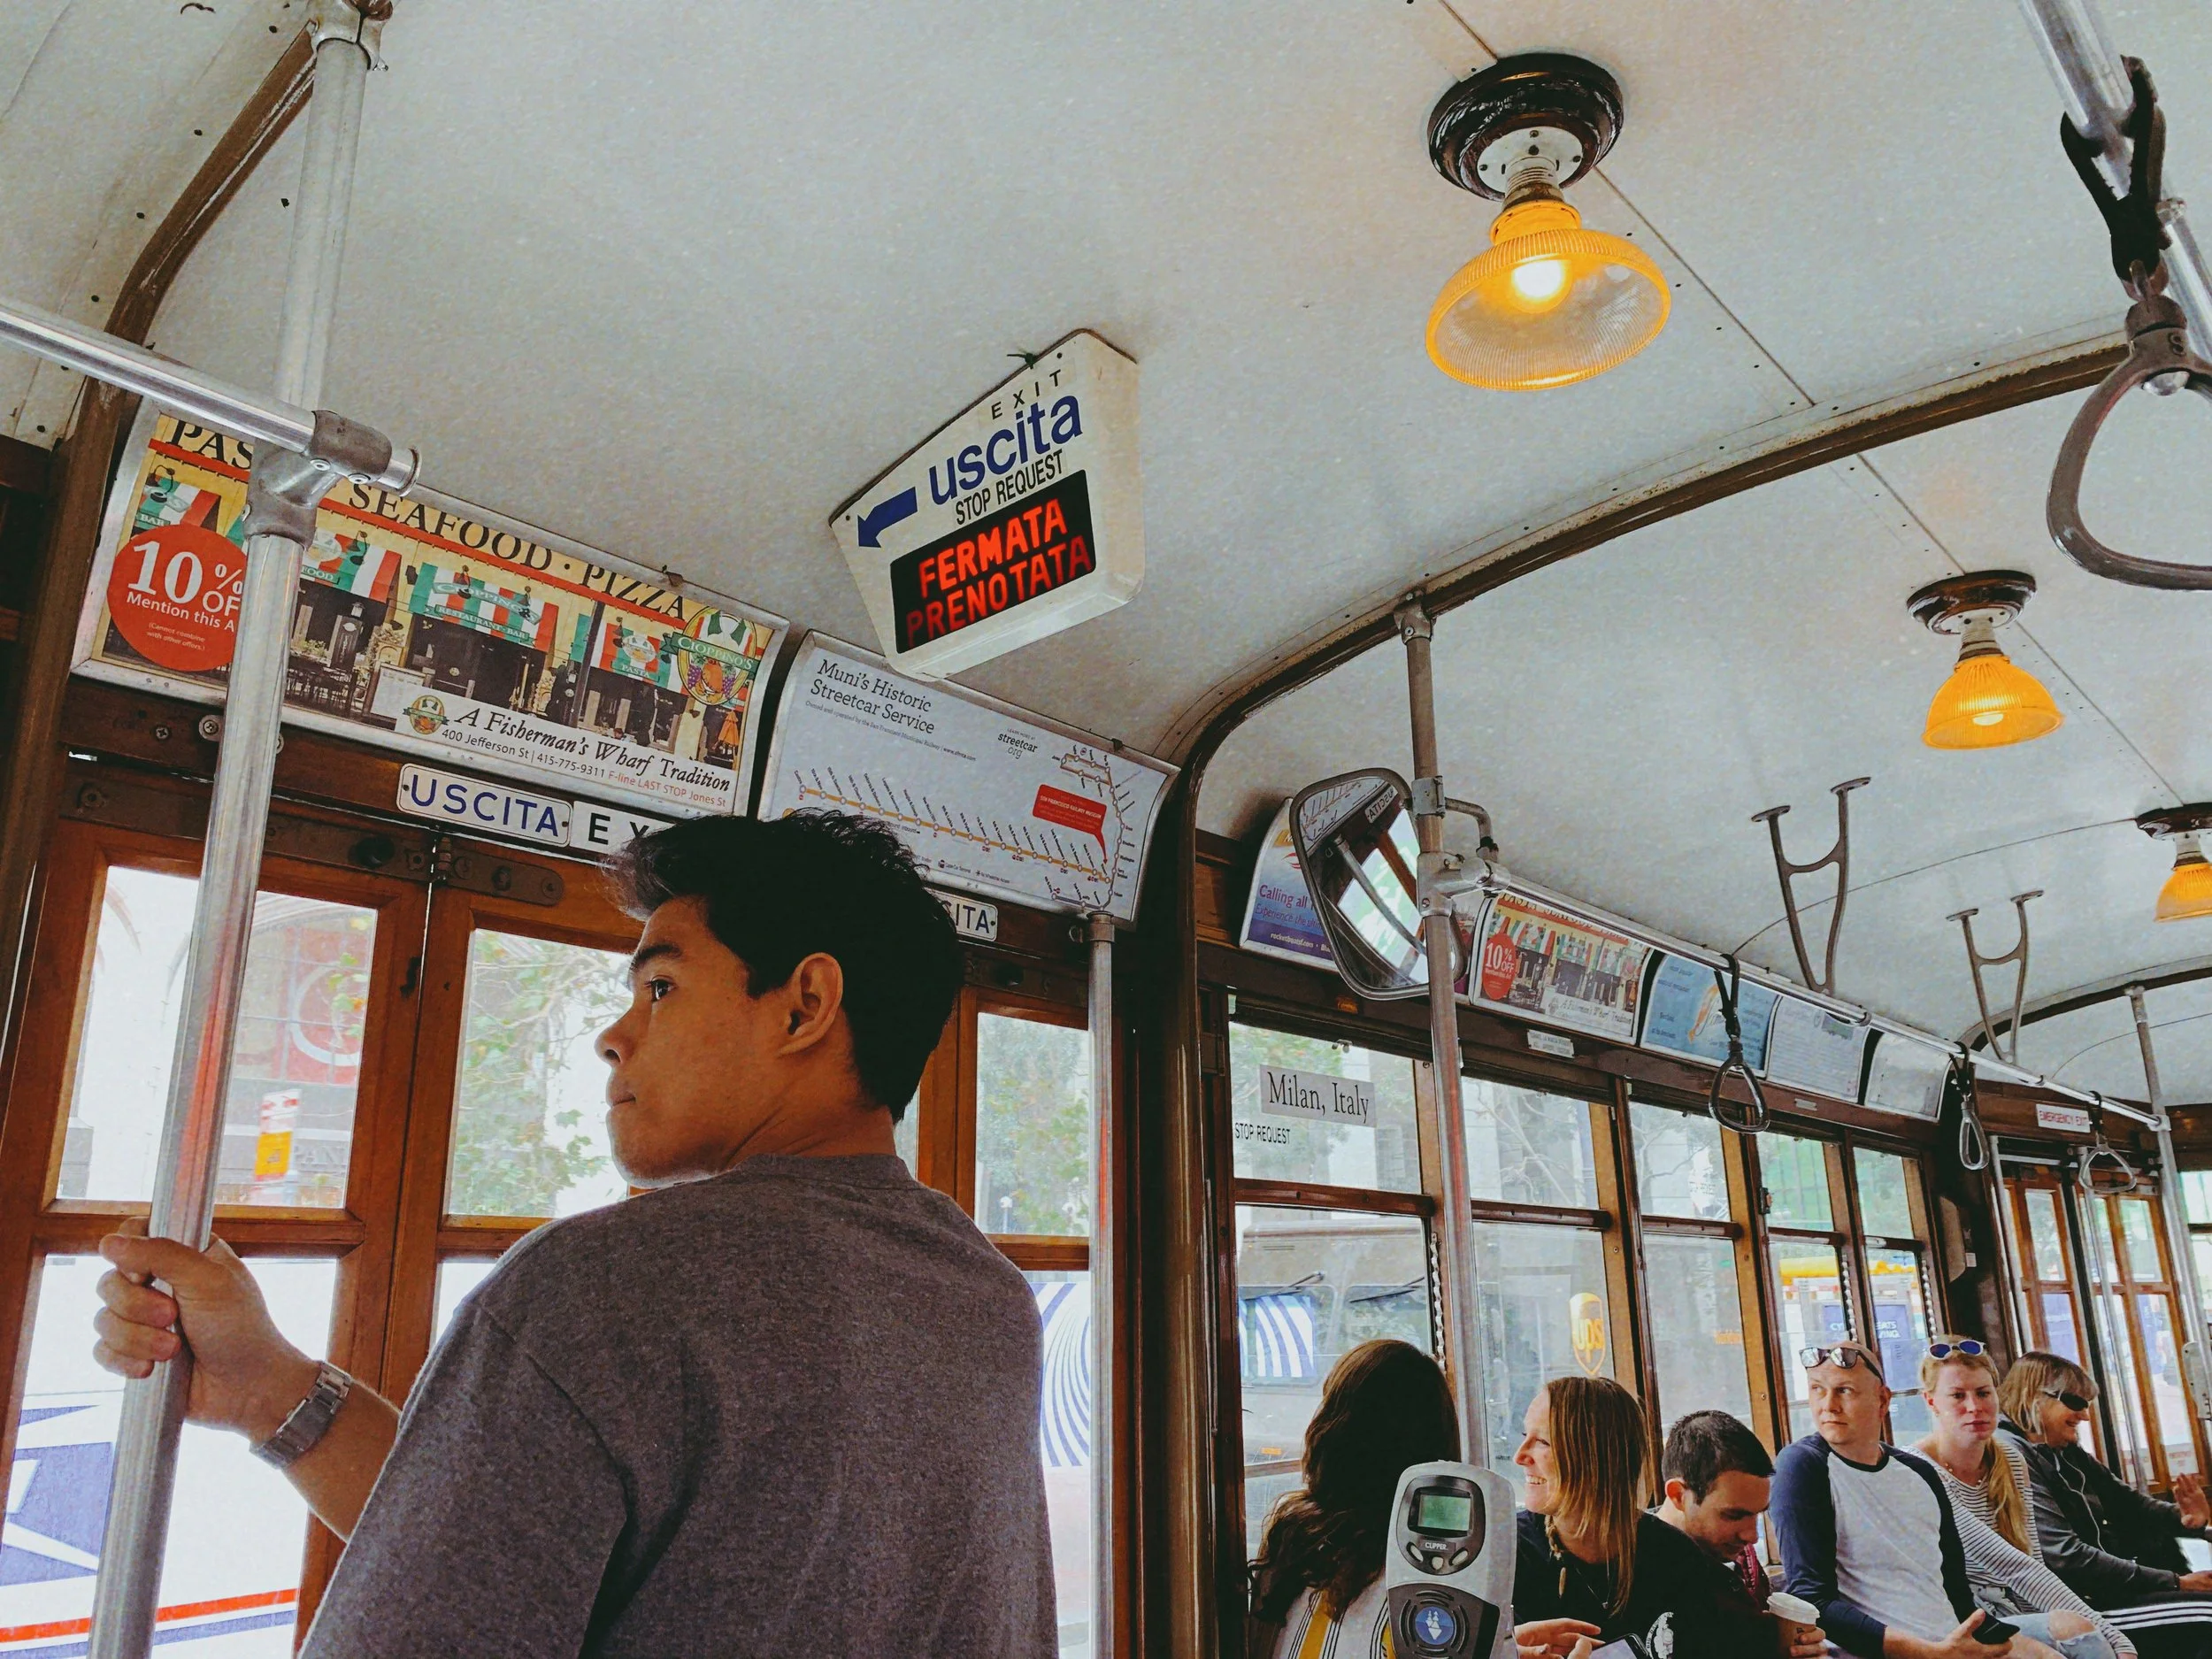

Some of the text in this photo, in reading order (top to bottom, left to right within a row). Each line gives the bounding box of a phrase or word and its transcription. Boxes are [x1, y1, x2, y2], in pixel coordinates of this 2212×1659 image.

[991, 369, 1062, 420] EXIT
[928, 395, 1083, 505] uscita
[956, 449, 1064, 526] STOP REQUEST
[349, 483, 552, 571] SEAFOOD
[579, 564, 684, 620] PIZZA
[918, 497, 1068, 598] FERMATA
[127, 591, 189, 619] Mention
[194, 611, 221, 628] this
[905, 534, 1093, 649] PRENOTATA
[622, 664, 650, 678] PASTA
[678, 637, 754, 670] CIOPPINO'S
[810, 679, 935, 734] Streetcar Service
[817, 658, 932, 712] Muni's Historic
[442, 729, 726, 807] 400 Jefferson St 415-775-9311 F-line LAST STOP Jones St
[454, 708, 731, 792] A Fisherman's Wharf Tradition
[997, 732, 1038, 753] streetcar
[411, 774, 559, 836] USCITA
[1256, 902, 1294, 921] Experience
[1294, 915, 1307, 926] the
[1259, 884, 1308, 909] Calling all
[1486, 942, 1512, 970] 10%
[1501, 961, 1515, 973] OFF
[1267, 1071, 1370, 1124] Milan, Italy
[1235, 1122, 1291, 1145] STOP REQUEST
[1425, 1541, 1448, 1550] CLIPPER
